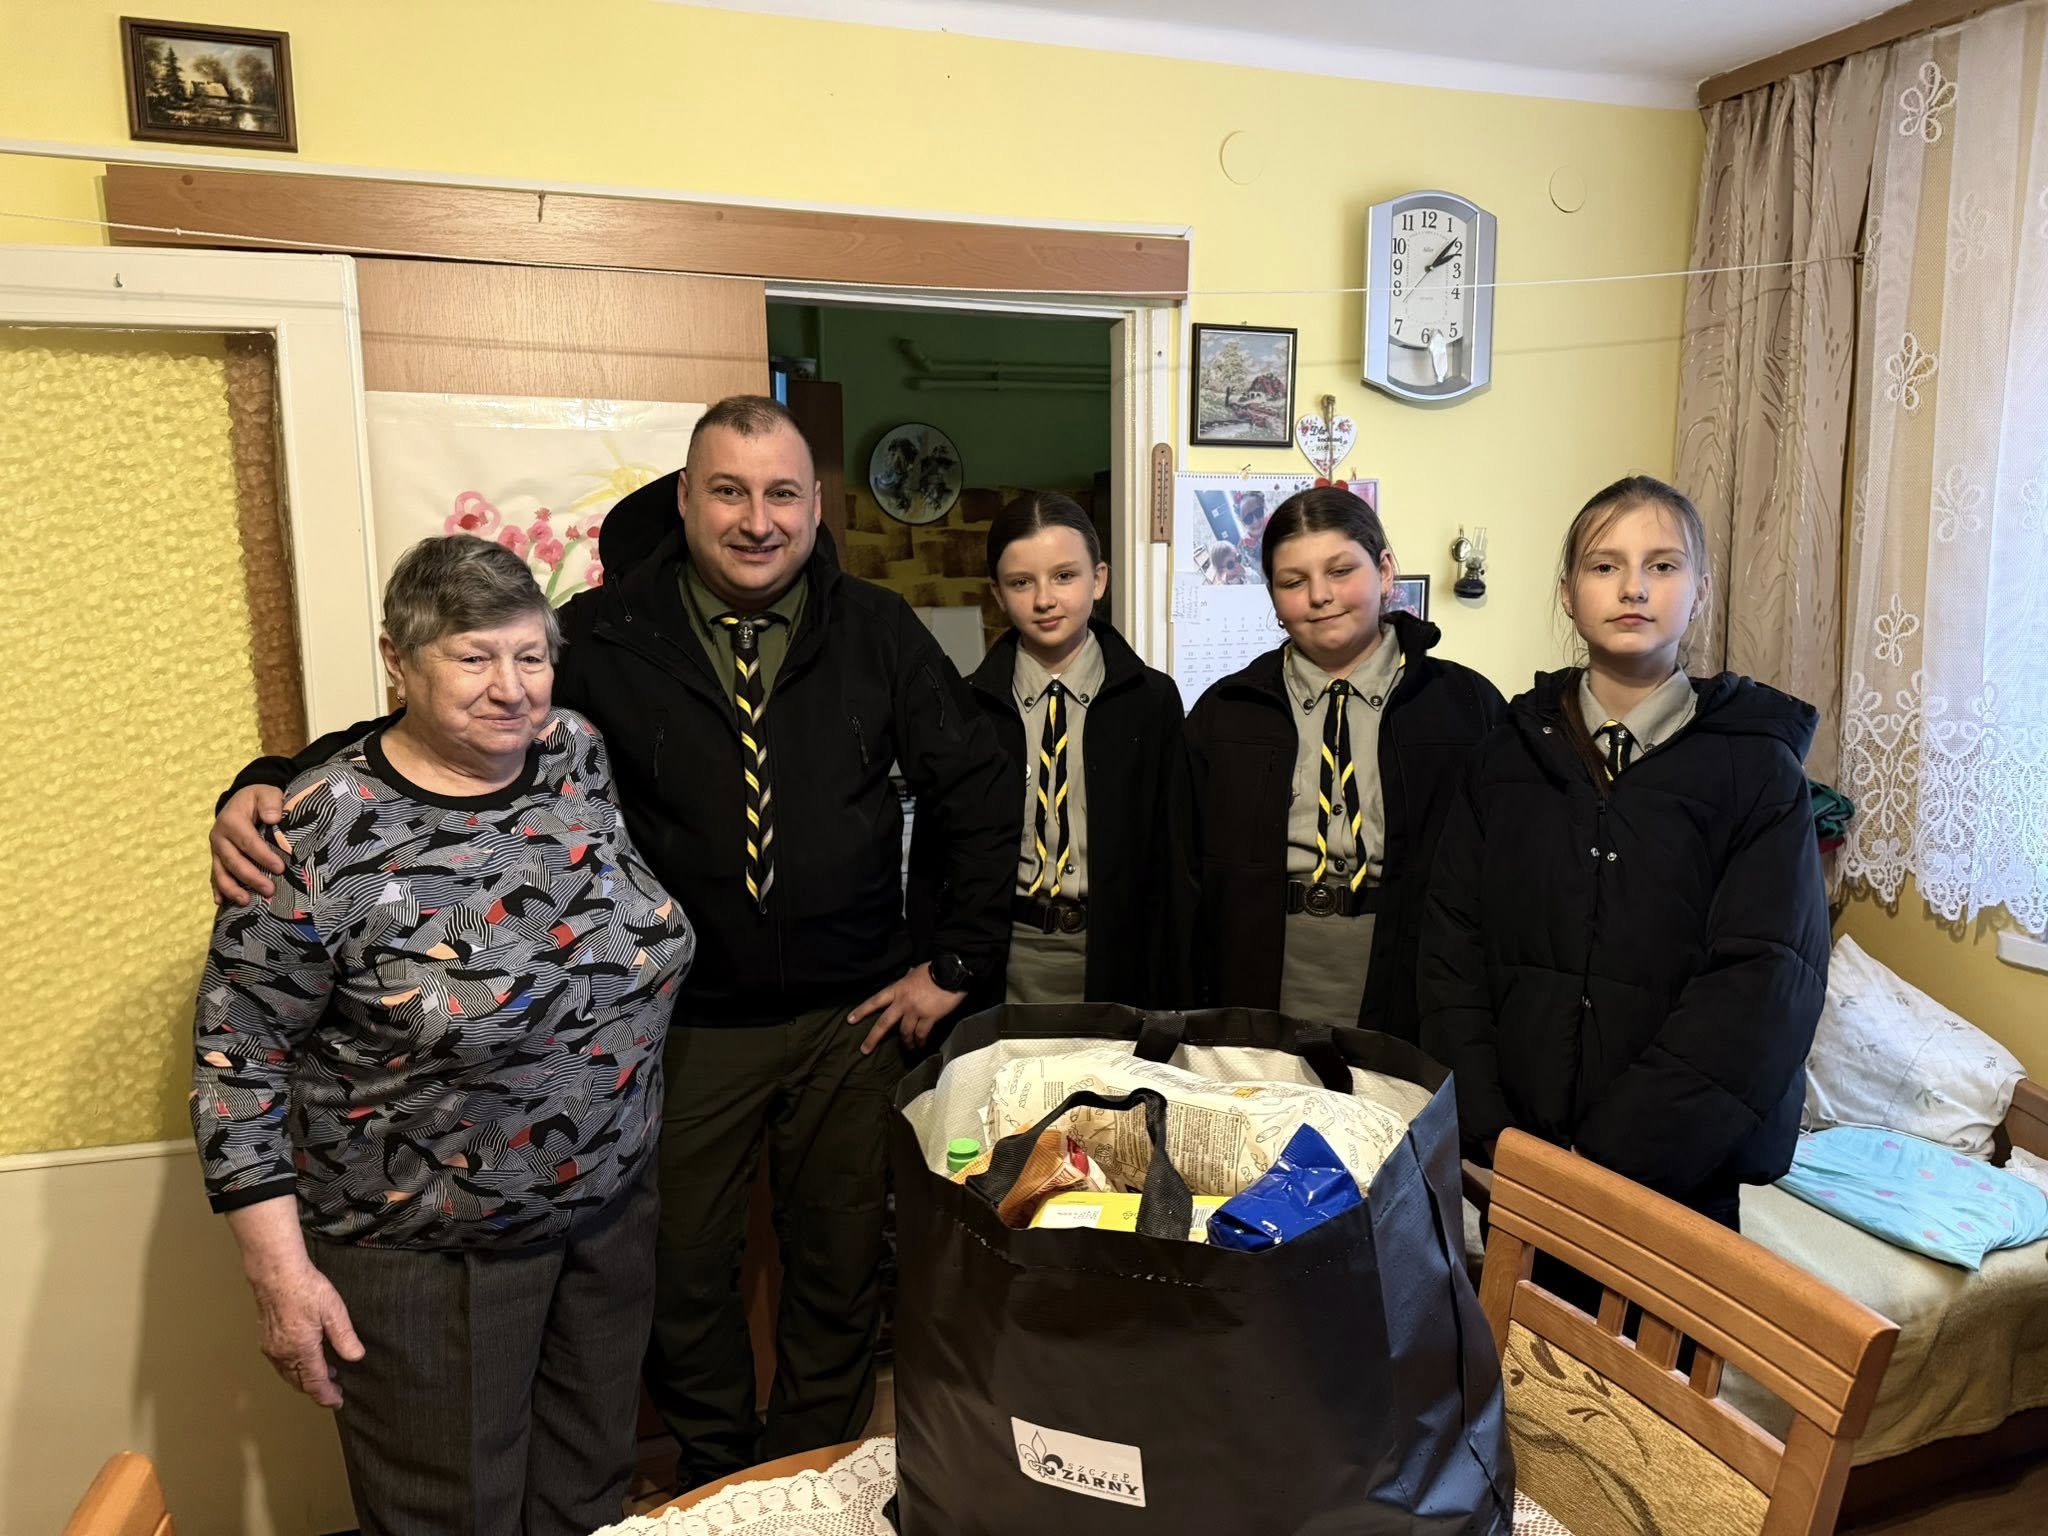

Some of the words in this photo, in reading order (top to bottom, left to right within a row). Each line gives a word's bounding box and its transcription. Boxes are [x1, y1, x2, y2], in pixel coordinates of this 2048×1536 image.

[1402, 213, 1415, 231] 11
[1421, 211, 1438, 229] 12
[1447, 217, 1453, 232] 1
[1392, 238, 1407, 255] 10
[1454, 240, 1463, 257] 2
[1393, 259, 1403, 276] 9
[1452, 263, 1461, 279] 3
[1392, 280, 1402, 297] 8
[1451, 284, 1461, 300] 4
[1394, 318, 1403, 336] 7
[1449, 322, 1458, 338] 5
[1421, 328, 1430, 344] 6
[1067, 1462, 1131, 1484] SZCZEP
